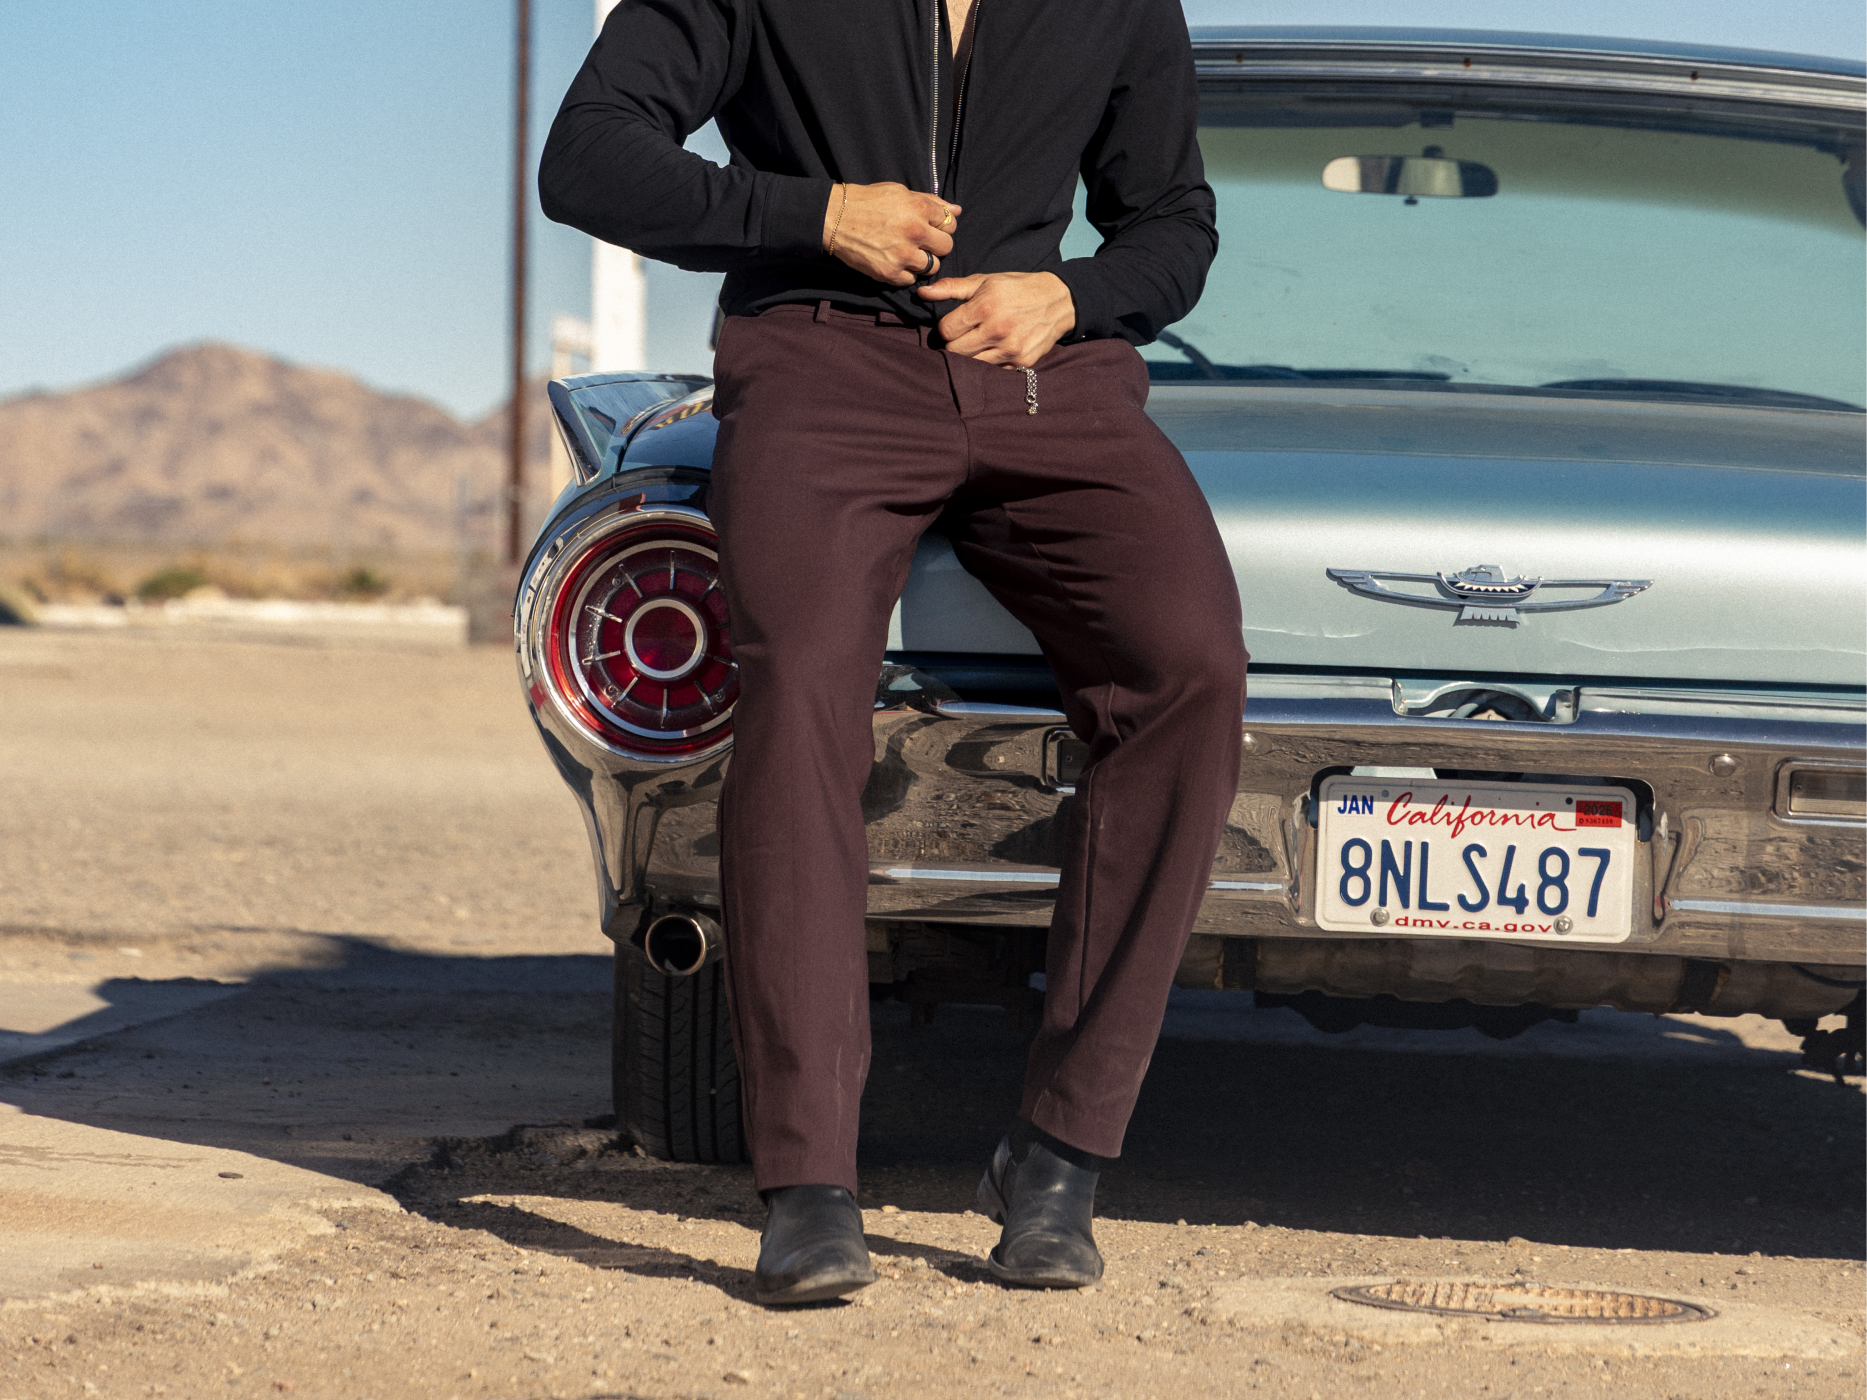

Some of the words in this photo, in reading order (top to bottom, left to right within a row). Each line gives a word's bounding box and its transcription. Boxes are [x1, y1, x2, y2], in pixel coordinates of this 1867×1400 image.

[1337, 794, 1374, 815] JAN
[1386, 791, 1577, 839] California
[1584, 804, 1613, 816] 2026
[1339, 837, 1611, 917] 8NLS487
[1394, 915, 1553, 933] dmv.ca.gov
